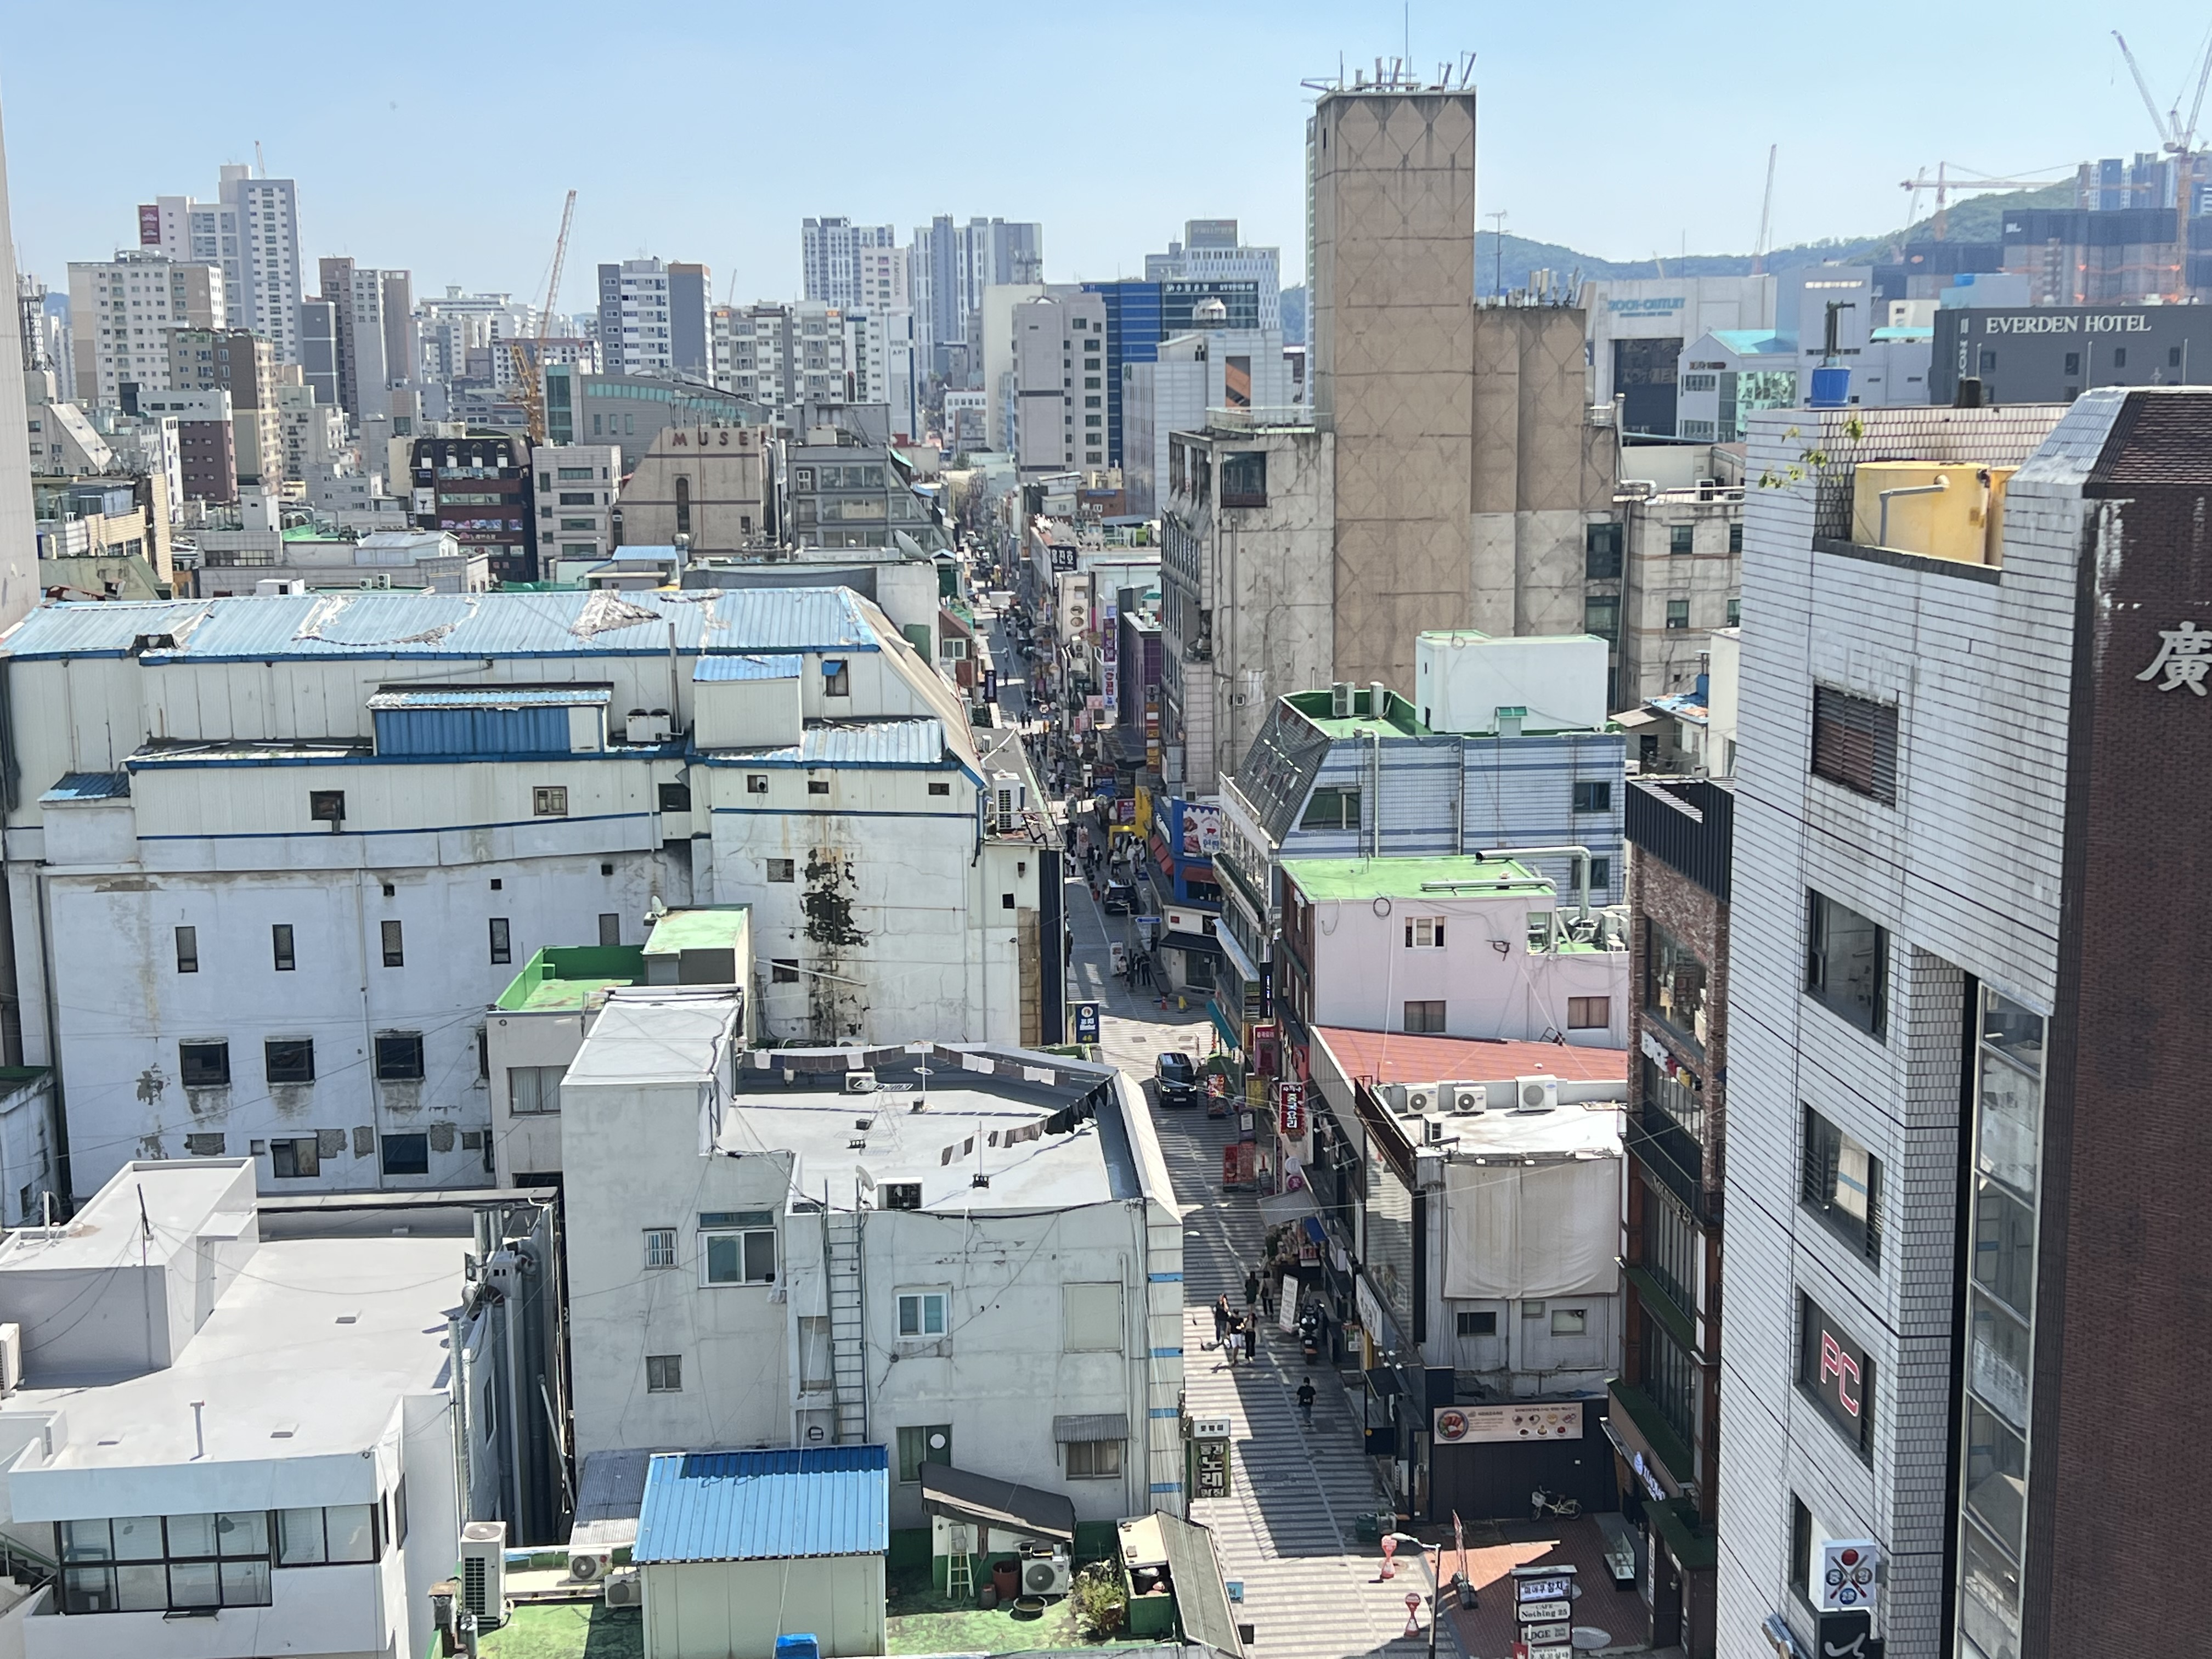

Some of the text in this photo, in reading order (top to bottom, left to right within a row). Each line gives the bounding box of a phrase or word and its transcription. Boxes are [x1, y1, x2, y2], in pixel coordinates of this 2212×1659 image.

[1985, 315, 2152, 334] EVERDEN HOTEL
[2136, 620, 2212, 697] 廣
[1821, 1329, 1860, 1418] PC
